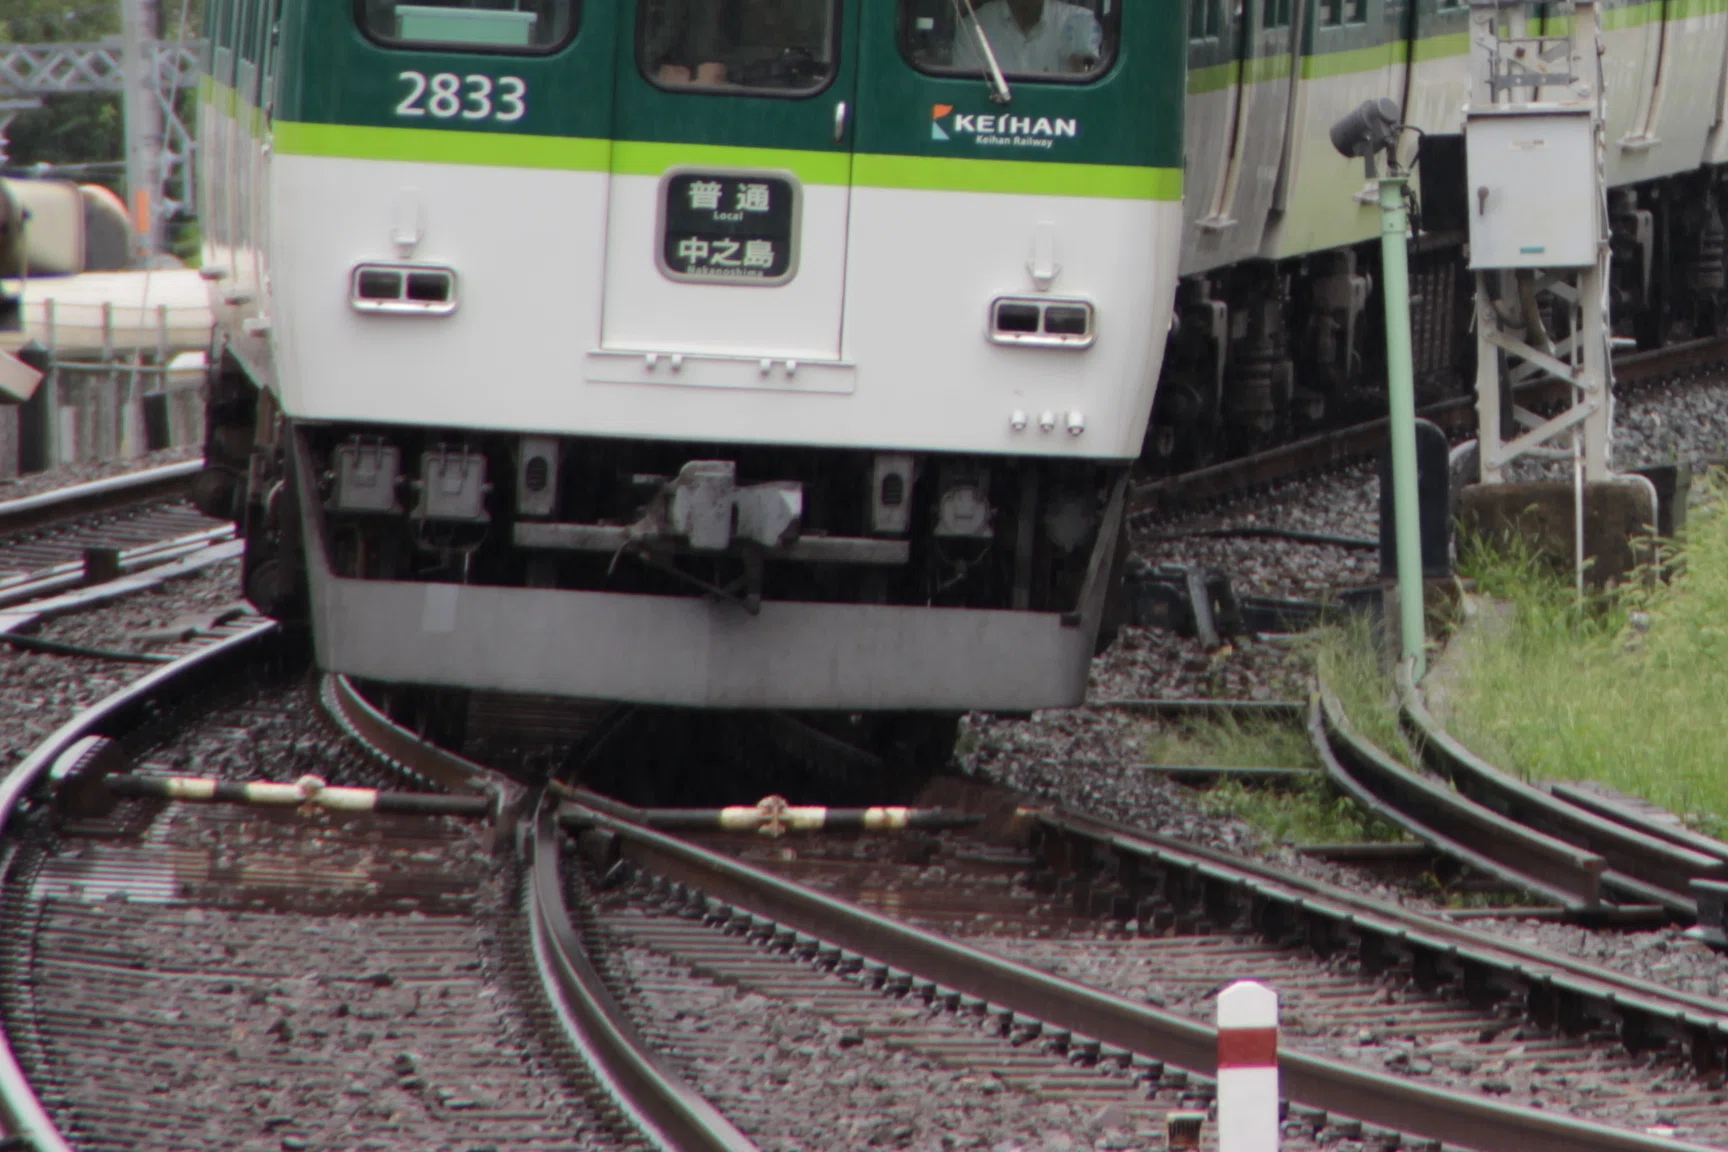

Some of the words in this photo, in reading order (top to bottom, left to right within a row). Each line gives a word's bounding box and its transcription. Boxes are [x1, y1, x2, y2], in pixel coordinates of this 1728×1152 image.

[396, 71, 526, 121] 2833
[955, 113, 1076, 137] KEIHAN
[976, 134, 1011, 146] Keihan
[1013, 136, 1053, 149] Railway
[689, 180, 770, 211] 普通
[713, 210, 744, 221] Local
[678, 235, 775, 268] 中之島
